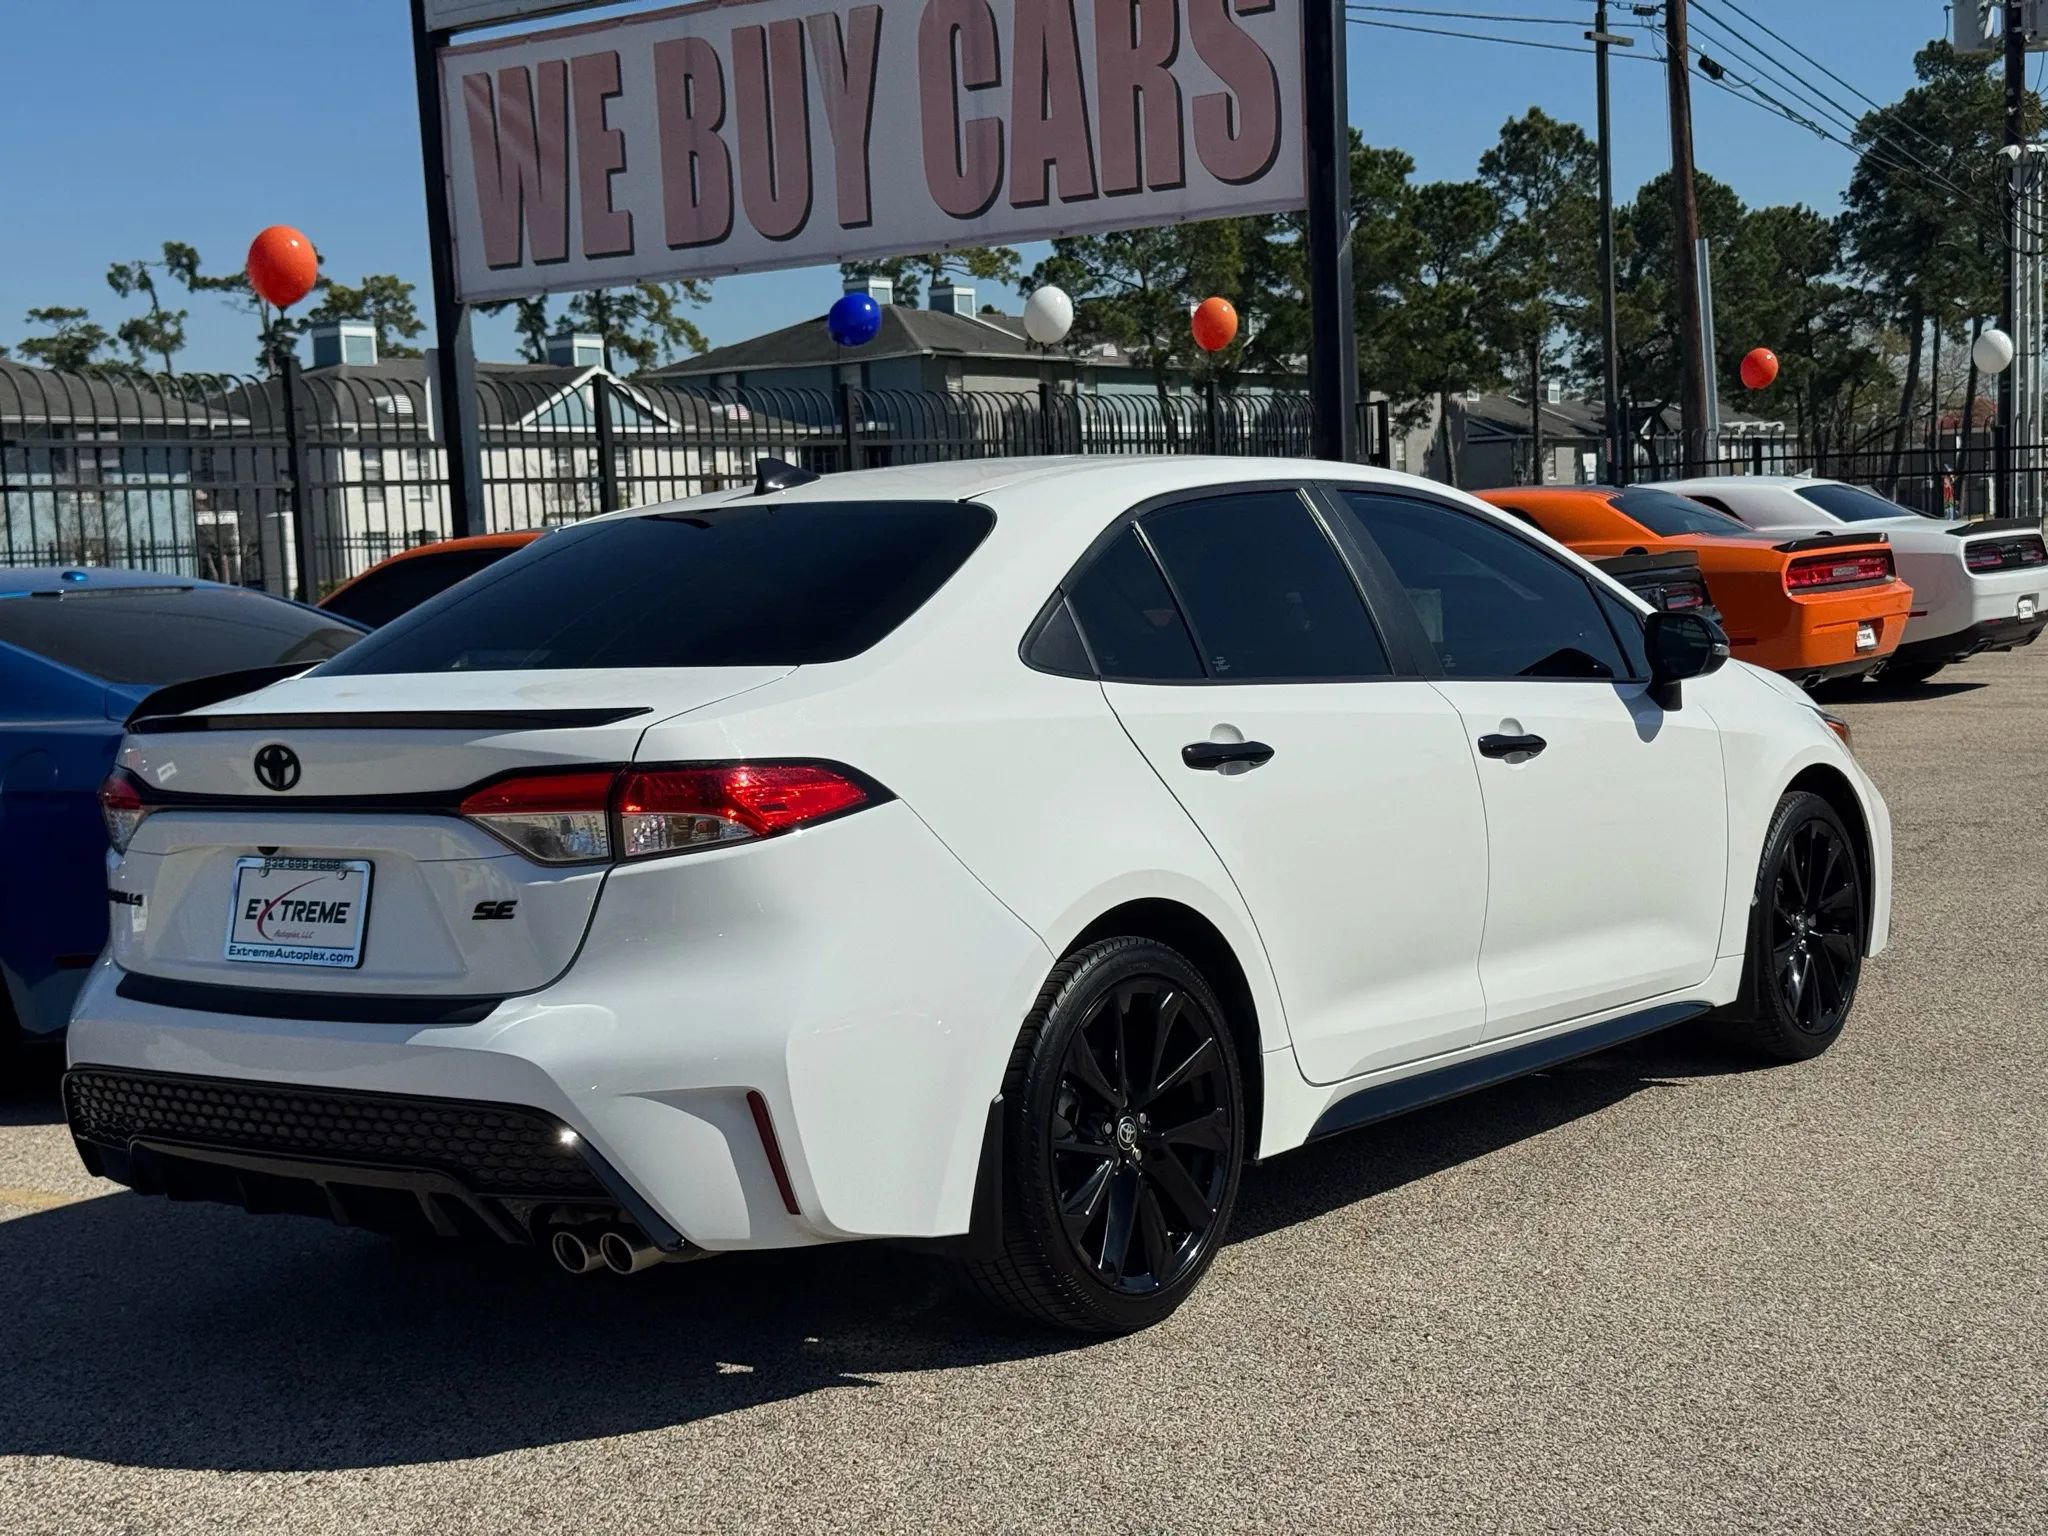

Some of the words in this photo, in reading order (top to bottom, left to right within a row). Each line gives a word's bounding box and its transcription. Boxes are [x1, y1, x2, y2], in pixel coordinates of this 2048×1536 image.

[462, 50, 635, 271] WE
[653, 4, 884, 250] BUY
[918, 0, 1282, 219] CARS
[244, 898, 352, 924] EXTREME
[472, 899, 519, 921] SE
[228, 945, 354, 963] ExtremeAutoplex.com
